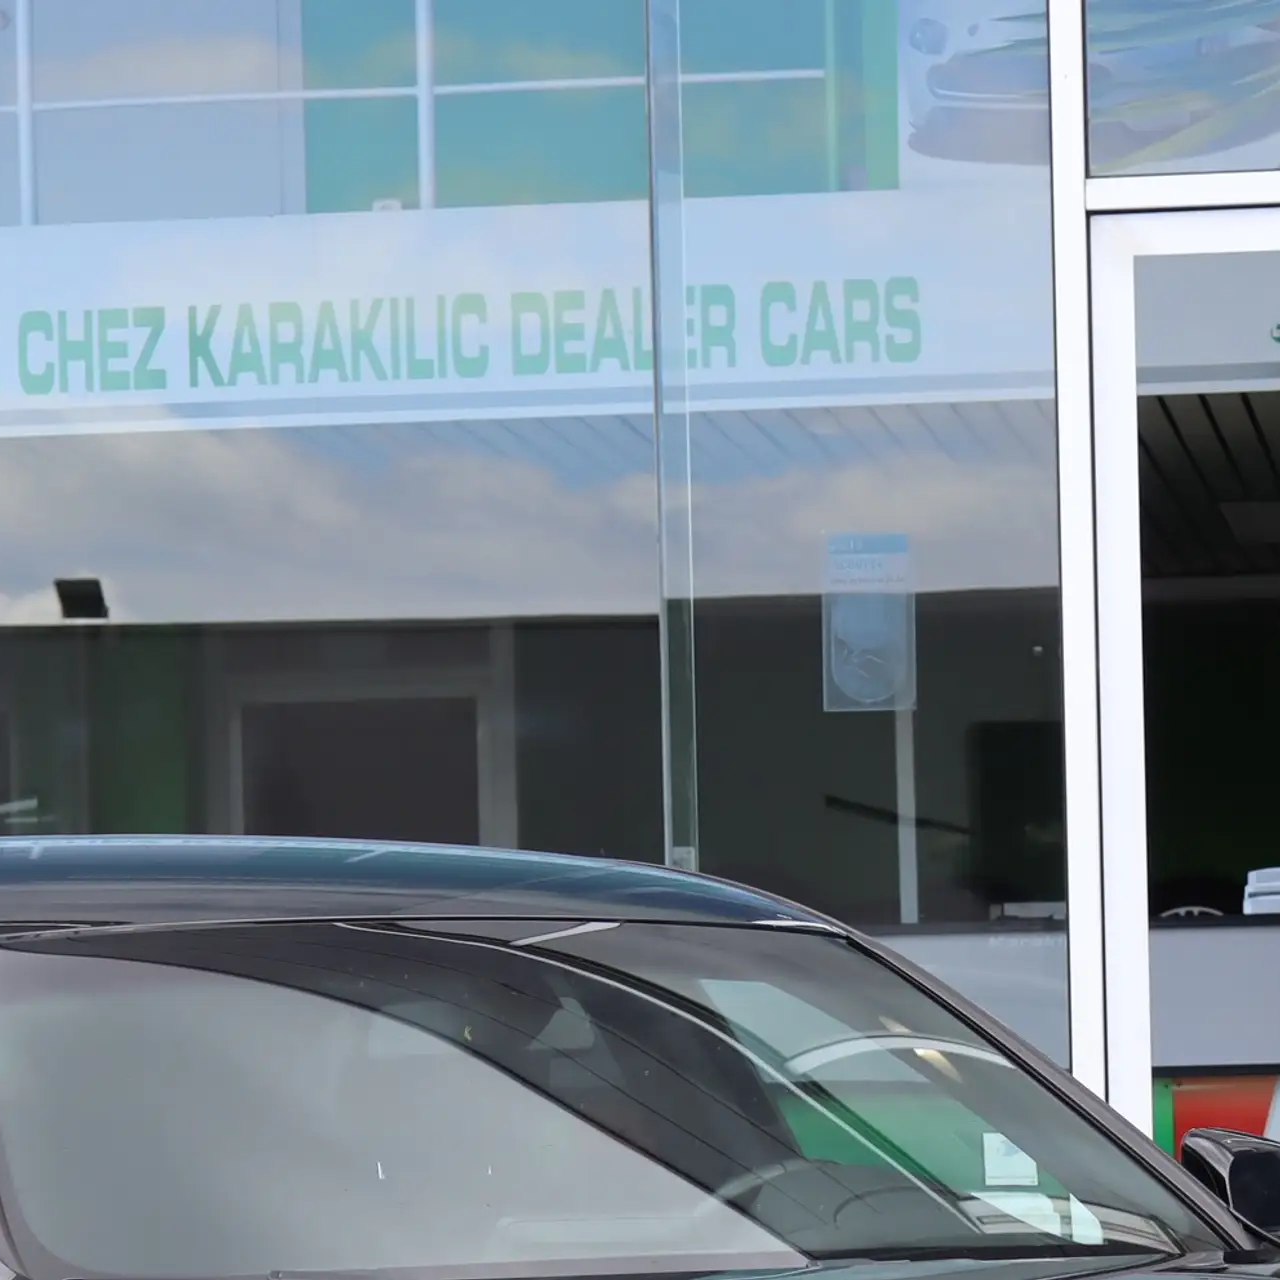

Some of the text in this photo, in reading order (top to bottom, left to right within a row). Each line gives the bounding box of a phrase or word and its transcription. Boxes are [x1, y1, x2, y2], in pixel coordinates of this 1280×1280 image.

[18, 305, 167, 396] CHEZ
[187, 292, 490, 389] KARAKILIC
[511, 283, 737, 377] DEALER
[760, 276, 922, 368] CARS
